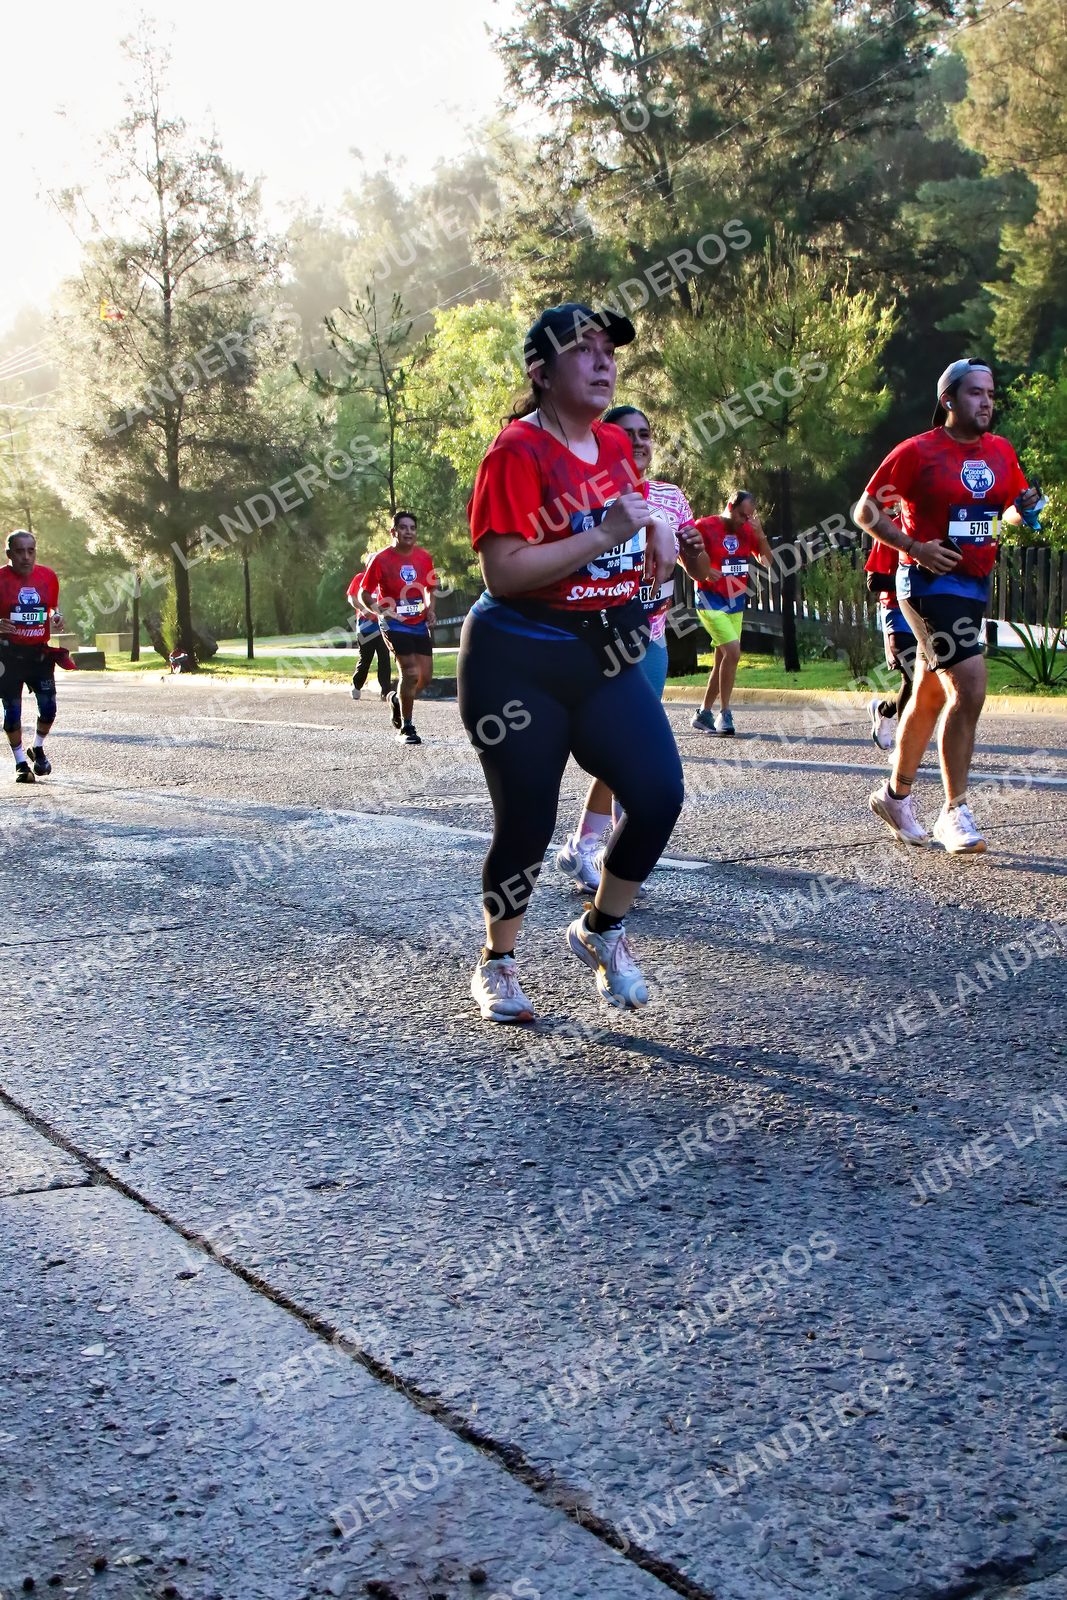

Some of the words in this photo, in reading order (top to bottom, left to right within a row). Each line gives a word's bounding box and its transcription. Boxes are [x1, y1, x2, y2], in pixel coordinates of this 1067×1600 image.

[970, 522, 989, 535] 5719
[22, 613, 38, 621] 5407
[14, 628, 46, 637] ANTIAGO
